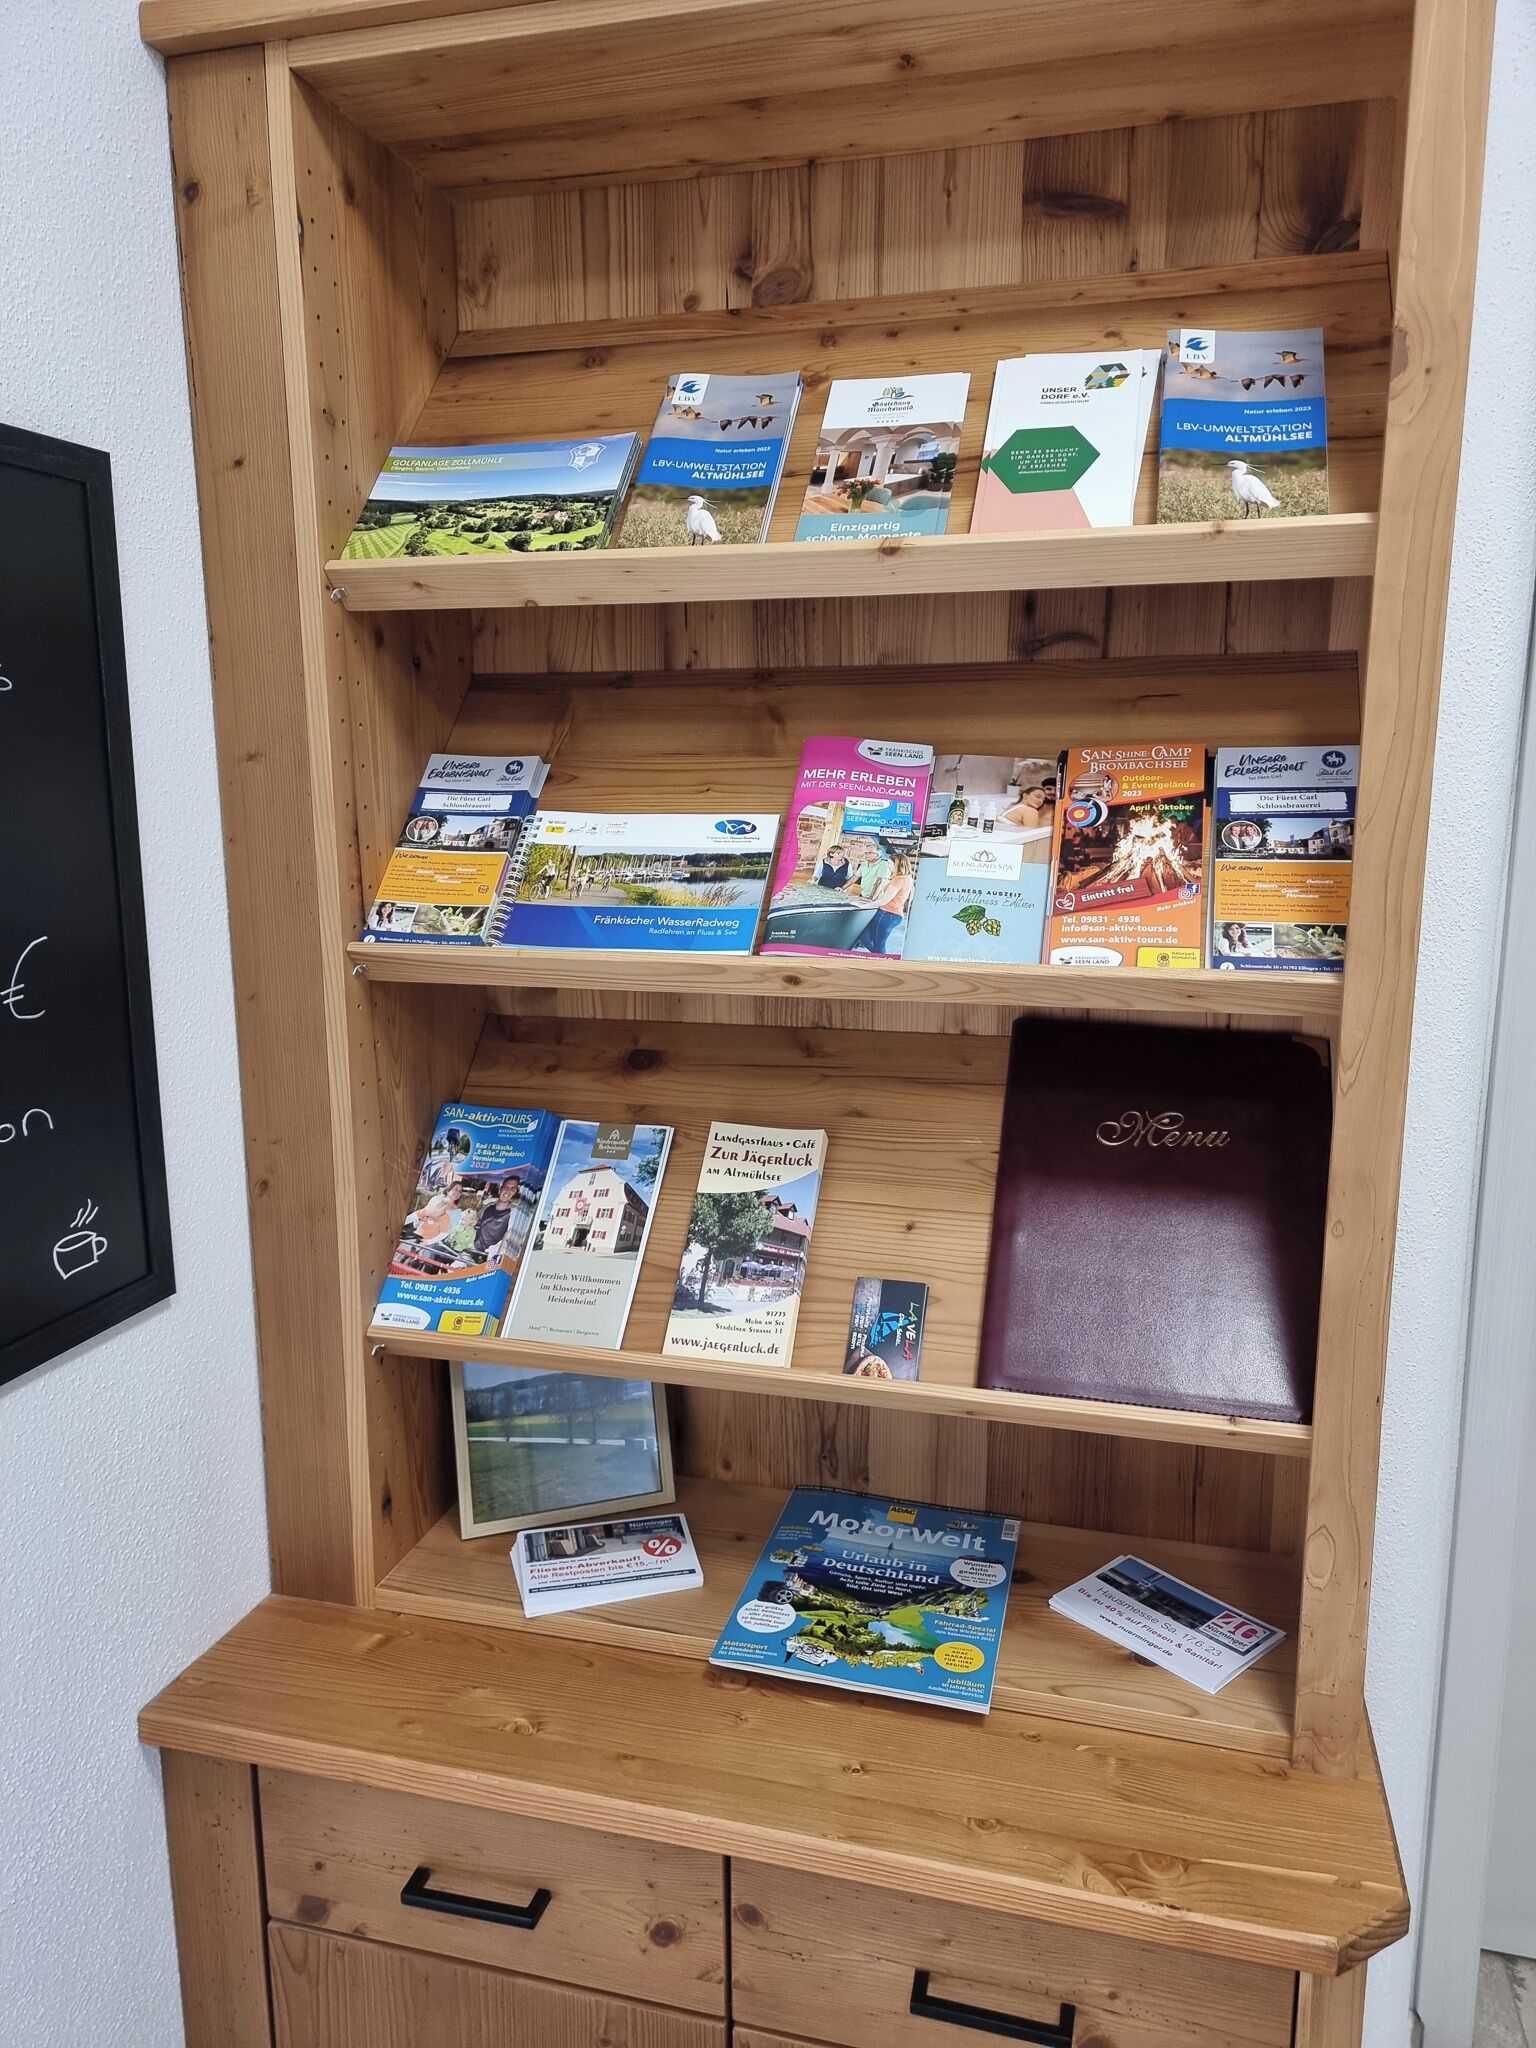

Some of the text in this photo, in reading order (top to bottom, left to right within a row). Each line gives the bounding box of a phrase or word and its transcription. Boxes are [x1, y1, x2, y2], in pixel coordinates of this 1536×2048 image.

[1176, 422, 1312, 434] LBV-UMWELTSTATION
[1225, 431, 1313, 443] ALTMÜHLSEE
[451, 457, 504, 465] ZOLLMÜHLE
[652, 460, 767, 470] LBV-UMWELTSTATION
[692, 470, 764, 480] ALTMÜHLSEE
[830, 521, 900, 532] Einzigartig
[806, 531, 854, 542] schöne
[1090, 760, 1188, 773] BROMBACHSEE
[803, 769, 916, 788] MEHR ERLEBEN
[839, 783, 915, 797] SEENLAND.CARD
[1129, 805, 1150, 813] April
[952, 860, 996, 869] SEENLAND
[998, 863, 1013, 871] SPA
[940, 887, 1022, 898] WELLNESS AUSZEIT
[1081, 885, 1134, 902] Eintritt frei
[594, 915, 740, 929] Fränkischer WasserRadweg
[649, 927, 685, 936] Radfahren
[1062, 924, 1178, 933] info@san-aktiv-tours.de
[1060, 936, 1178, 944] www.san-aktiv-tours.de
[444, 1107, 532, 1125] SAN-aktiv-TOURS
[1096, 1111, 1230, 1147] Menu
[472, 1155, 505, 1163] Vermietung
[535, 1272, 621, 1285] Herzlich Willkommen
[415, 1284, 437, 1292] 09831
[443, 1287, 461, 1295] 4936
[552, 1284, 612, 1296] Klostergasthof
[397, 1292, 484, 1306] www.san-aktiv-tours.de
[547, 1295, 597, 1306] Heidenheim!
[904, 1302, 920, 1360] LA VELA
[890, 1506, 916, 1515] ADAC
[808, 1509, 987, 1552] MotorWelt
[529, 1555, 641, 1574] Fliesen-Abverkauf!
[841, 1550, 927, 1571] Urlaub in
[963, 1561, 996, 1569] Wunsch-
[530, 1572, 548, 1580] Alle
[551, 1566, 606, 1579] Restposten
[608, 1563, 624, 1571] bis
[822, 1558, 940, 1585] Deutschland
[958, 1570, 997, 1578] gewinnen
[934, 1620, 996, 1632] Fahrrad-Spezial
[1096, 1587, 1223, 1657] Hausmesse Sa. 17.6.23
[1077, 1587, 1091, 1598] Bis
[1092, 1597, 1104, 1606] zu
[1104, 1604, 1116, 1613] 40
[1116, 1610, 1124, 1618] %
[1124, 1615, 1141, 1627] auf
[1141, 1624, 1174, 1645] Fliesen
[1184, 1646, 1223, 1670] Sanitär!
[1099, 1613, 1173, 1657] www.nuerminger.de
[1205, 1624, 1248, 1647] Nürminger
[722, 1641, 768, 1650] Motorsport
[947, 1678, 985, 1688] Jubiläum
